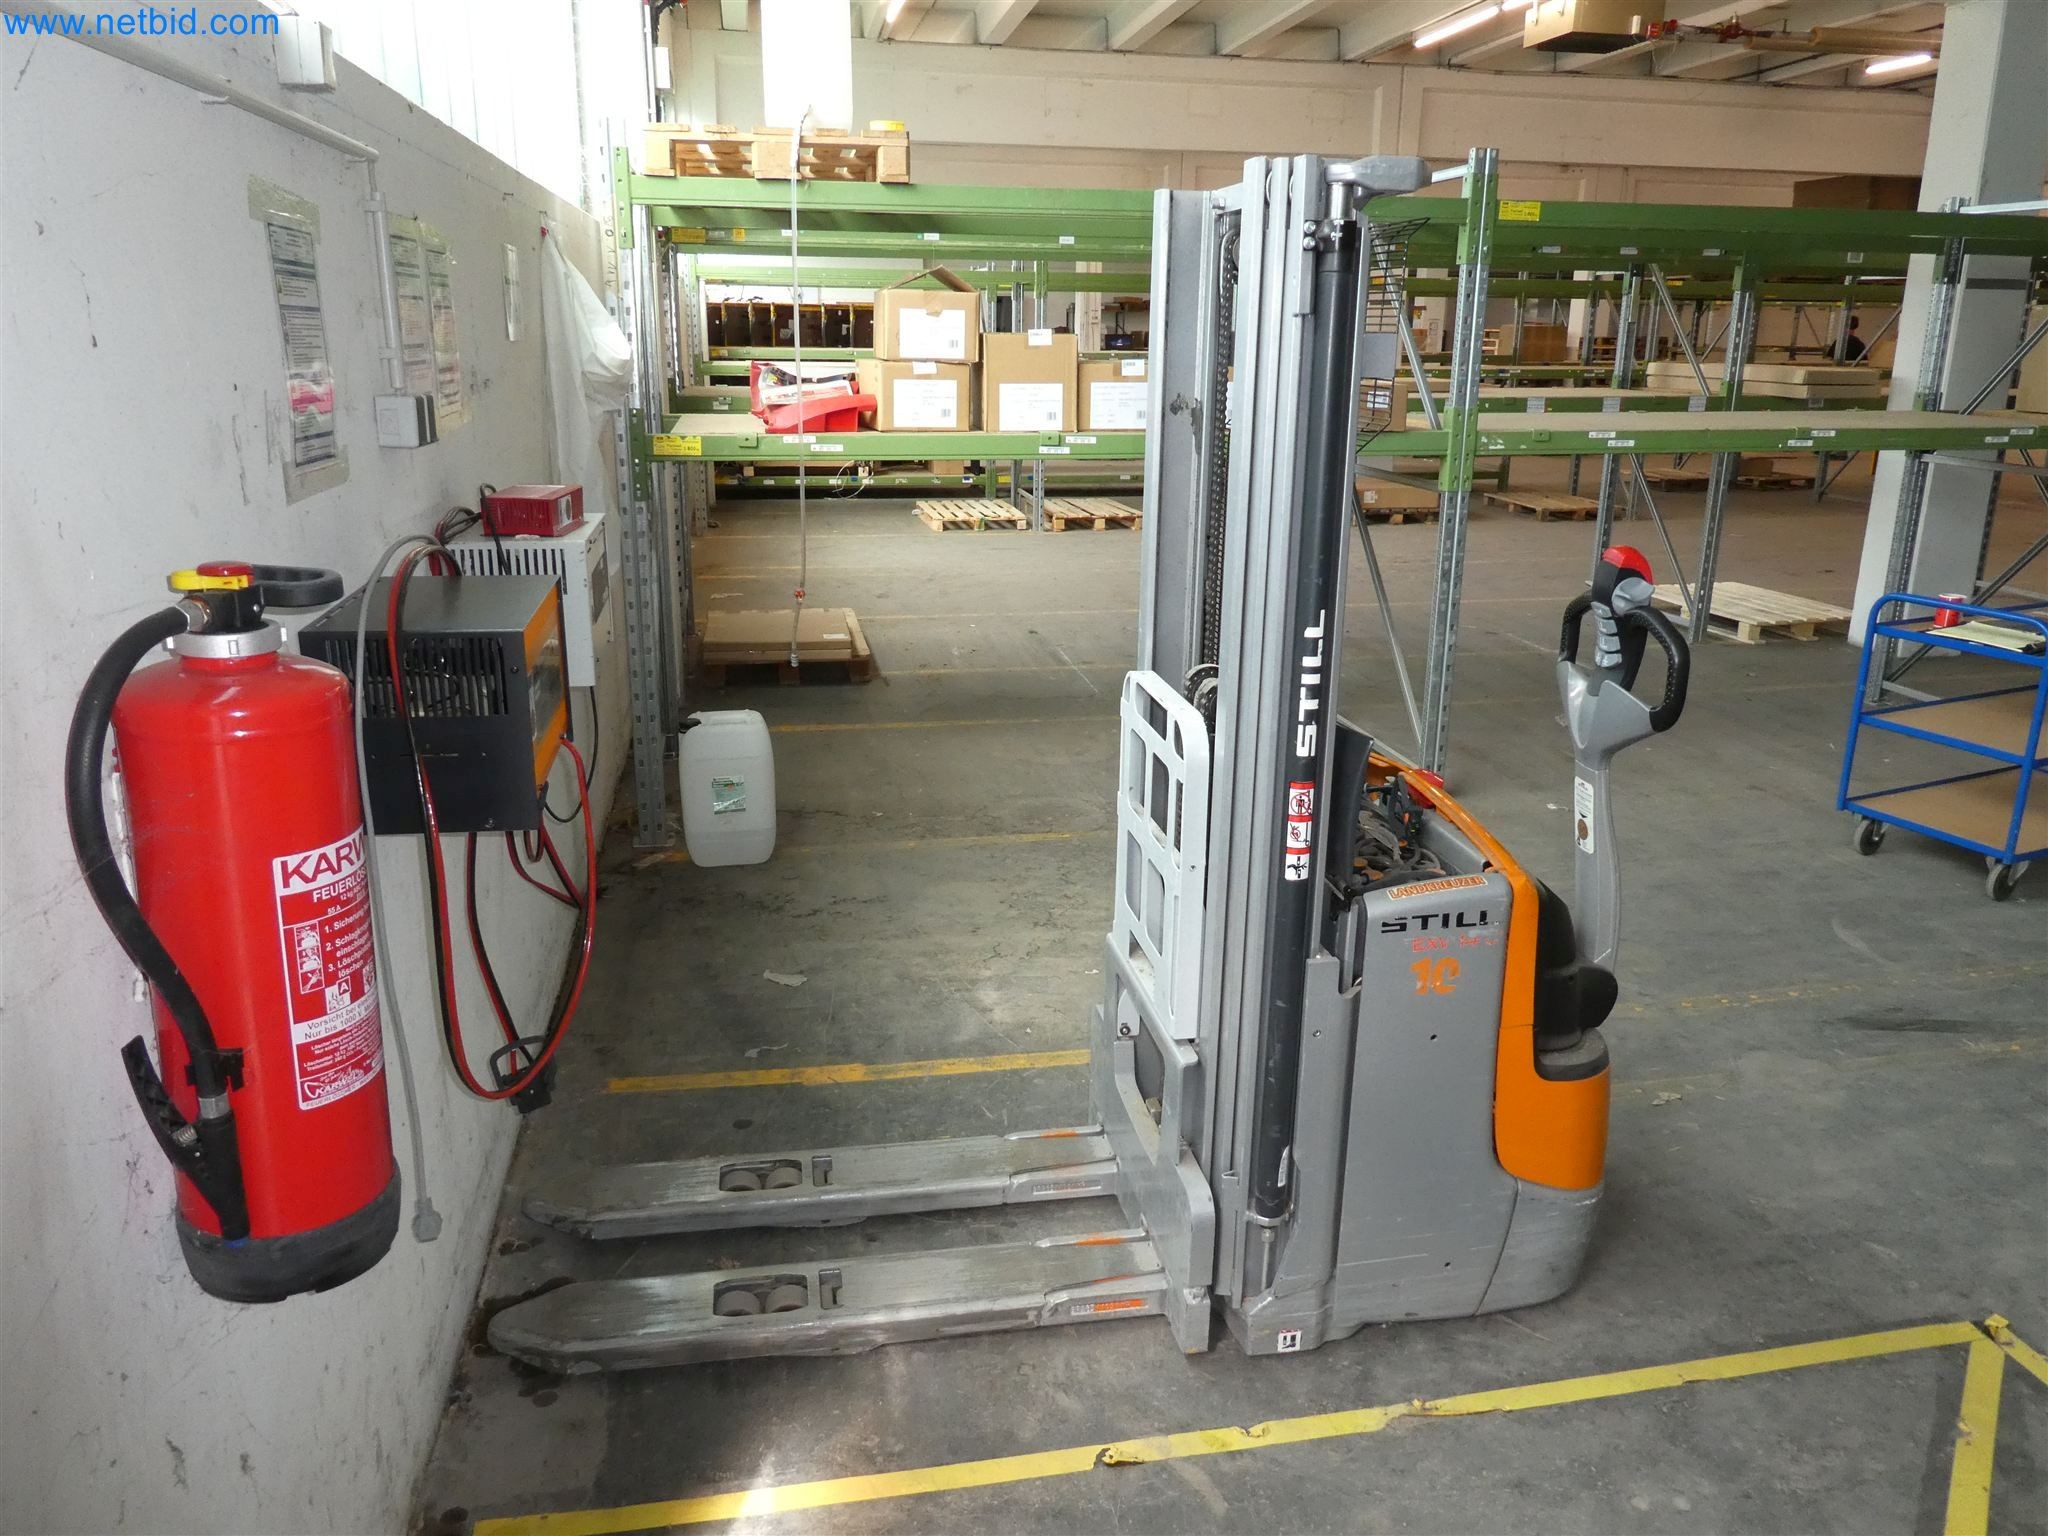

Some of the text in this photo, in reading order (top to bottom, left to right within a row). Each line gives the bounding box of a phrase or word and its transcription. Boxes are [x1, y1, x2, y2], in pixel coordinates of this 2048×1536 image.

[1296, 609, 1326, 757] STILL
[1388, 875, 1487, 899] LANDKREUZER
[324, 925, 333, 934] 1.
[1381, 910, 1488, 934] STILL
[326, 942, 334, 951] 2.
[328, 963, 336, 972] 3.
[1410, 956, 1461, 996] 10
[339, 981, 349, 993] A
[307, 1012, 345, 1031] Vorsicht
[304, 1029, 321, 1041] Nur
[324, 1025, 338, 1035] bis
